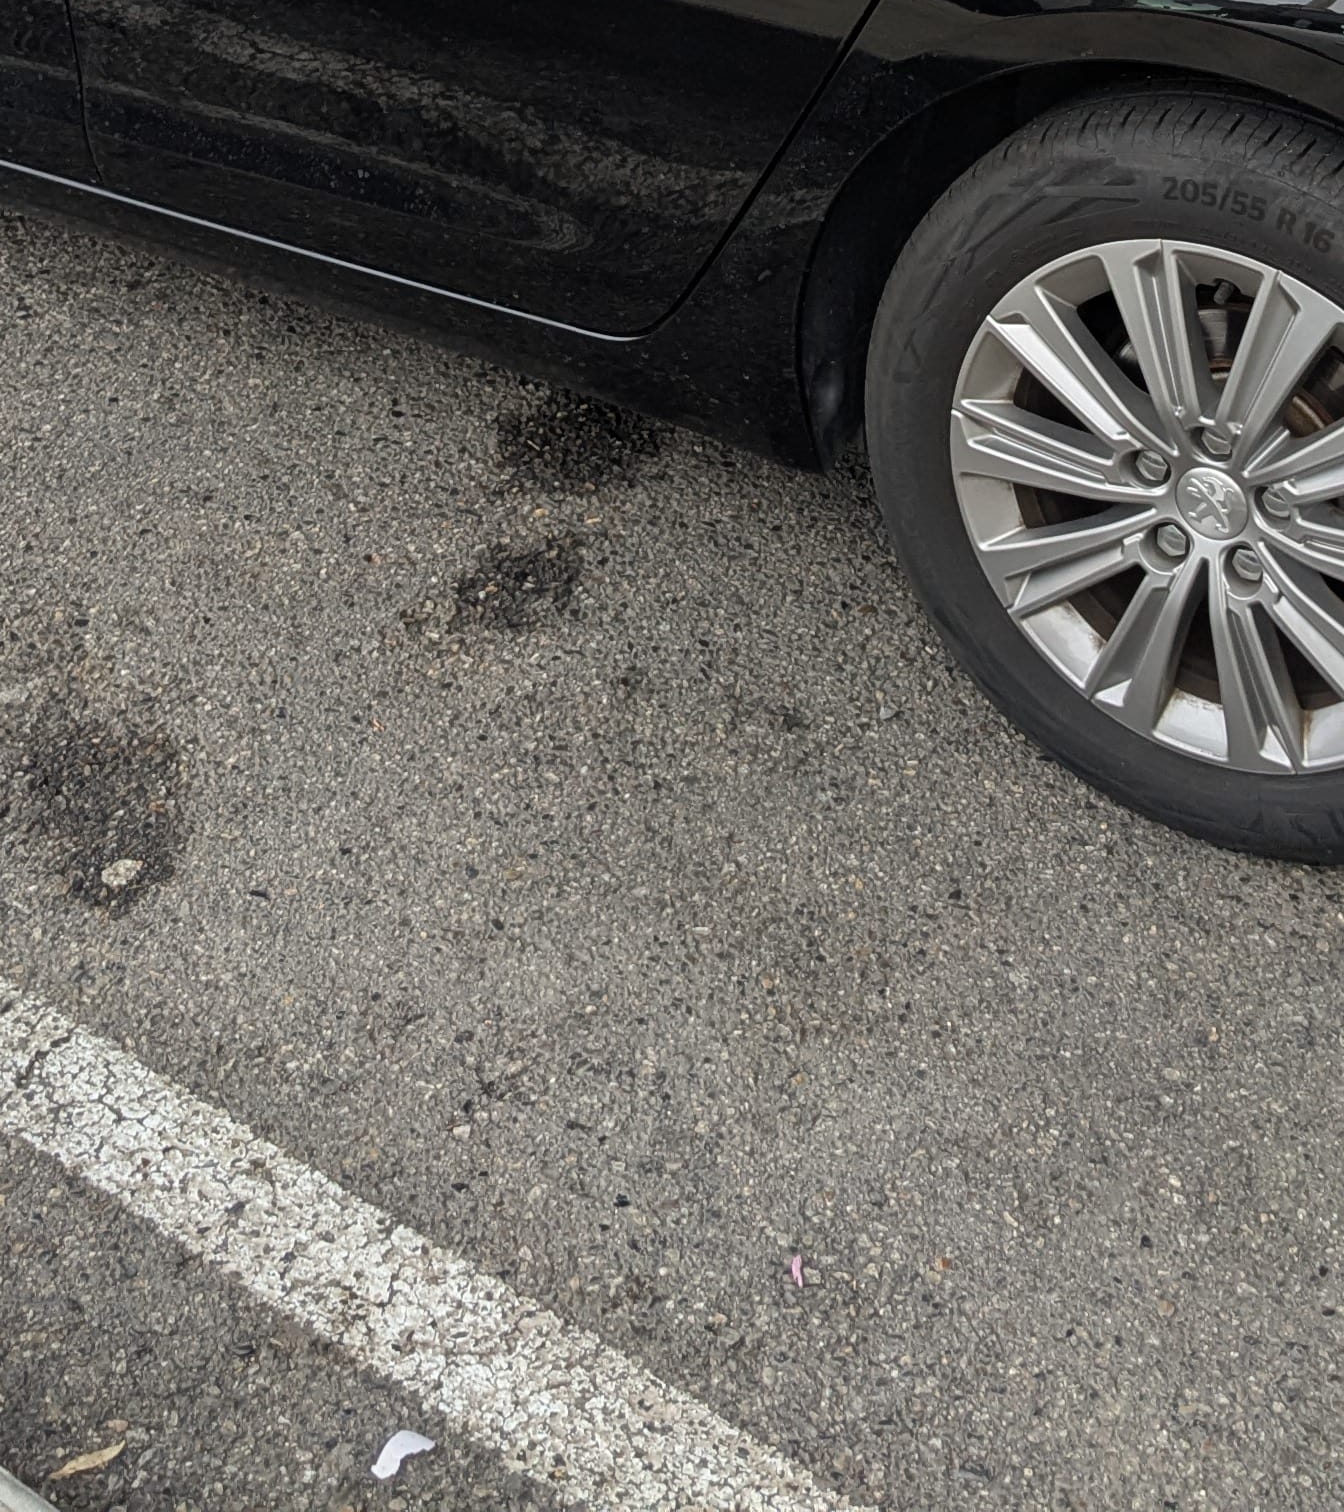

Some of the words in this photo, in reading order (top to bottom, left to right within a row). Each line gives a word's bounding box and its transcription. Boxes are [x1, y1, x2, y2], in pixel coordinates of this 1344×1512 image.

[1162, 176, 1267, 222] 205/55
[1276, 207, 1297, 236] R
[1303, 222, 1335, 253] 16
